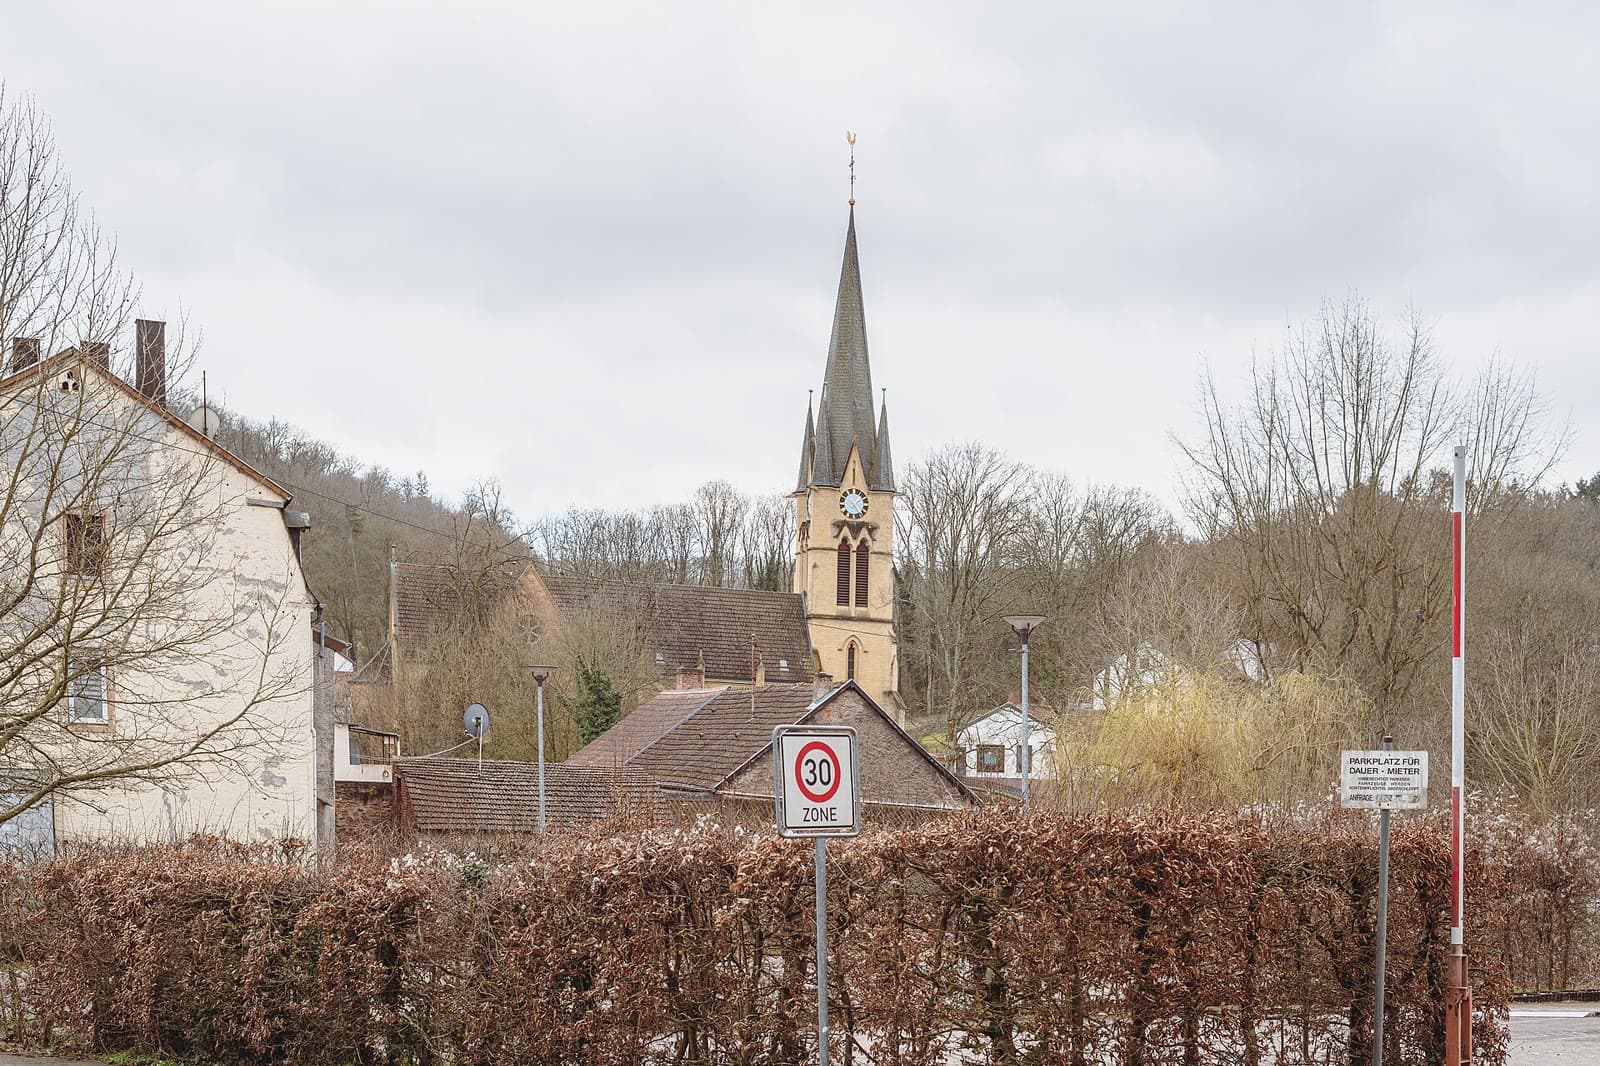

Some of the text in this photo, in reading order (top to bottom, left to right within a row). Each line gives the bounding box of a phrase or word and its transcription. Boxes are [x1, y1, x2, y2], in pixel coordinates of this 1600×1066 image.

[1349, 756, 1420, 766] PARKPLATZ FÜR
[804, 758, 831, 786] 30
[1349, 767, 1379, 775] DAUER
[1387, 768, 1420, 776] MIETER
[803, 807, 838, 822] ZONE
